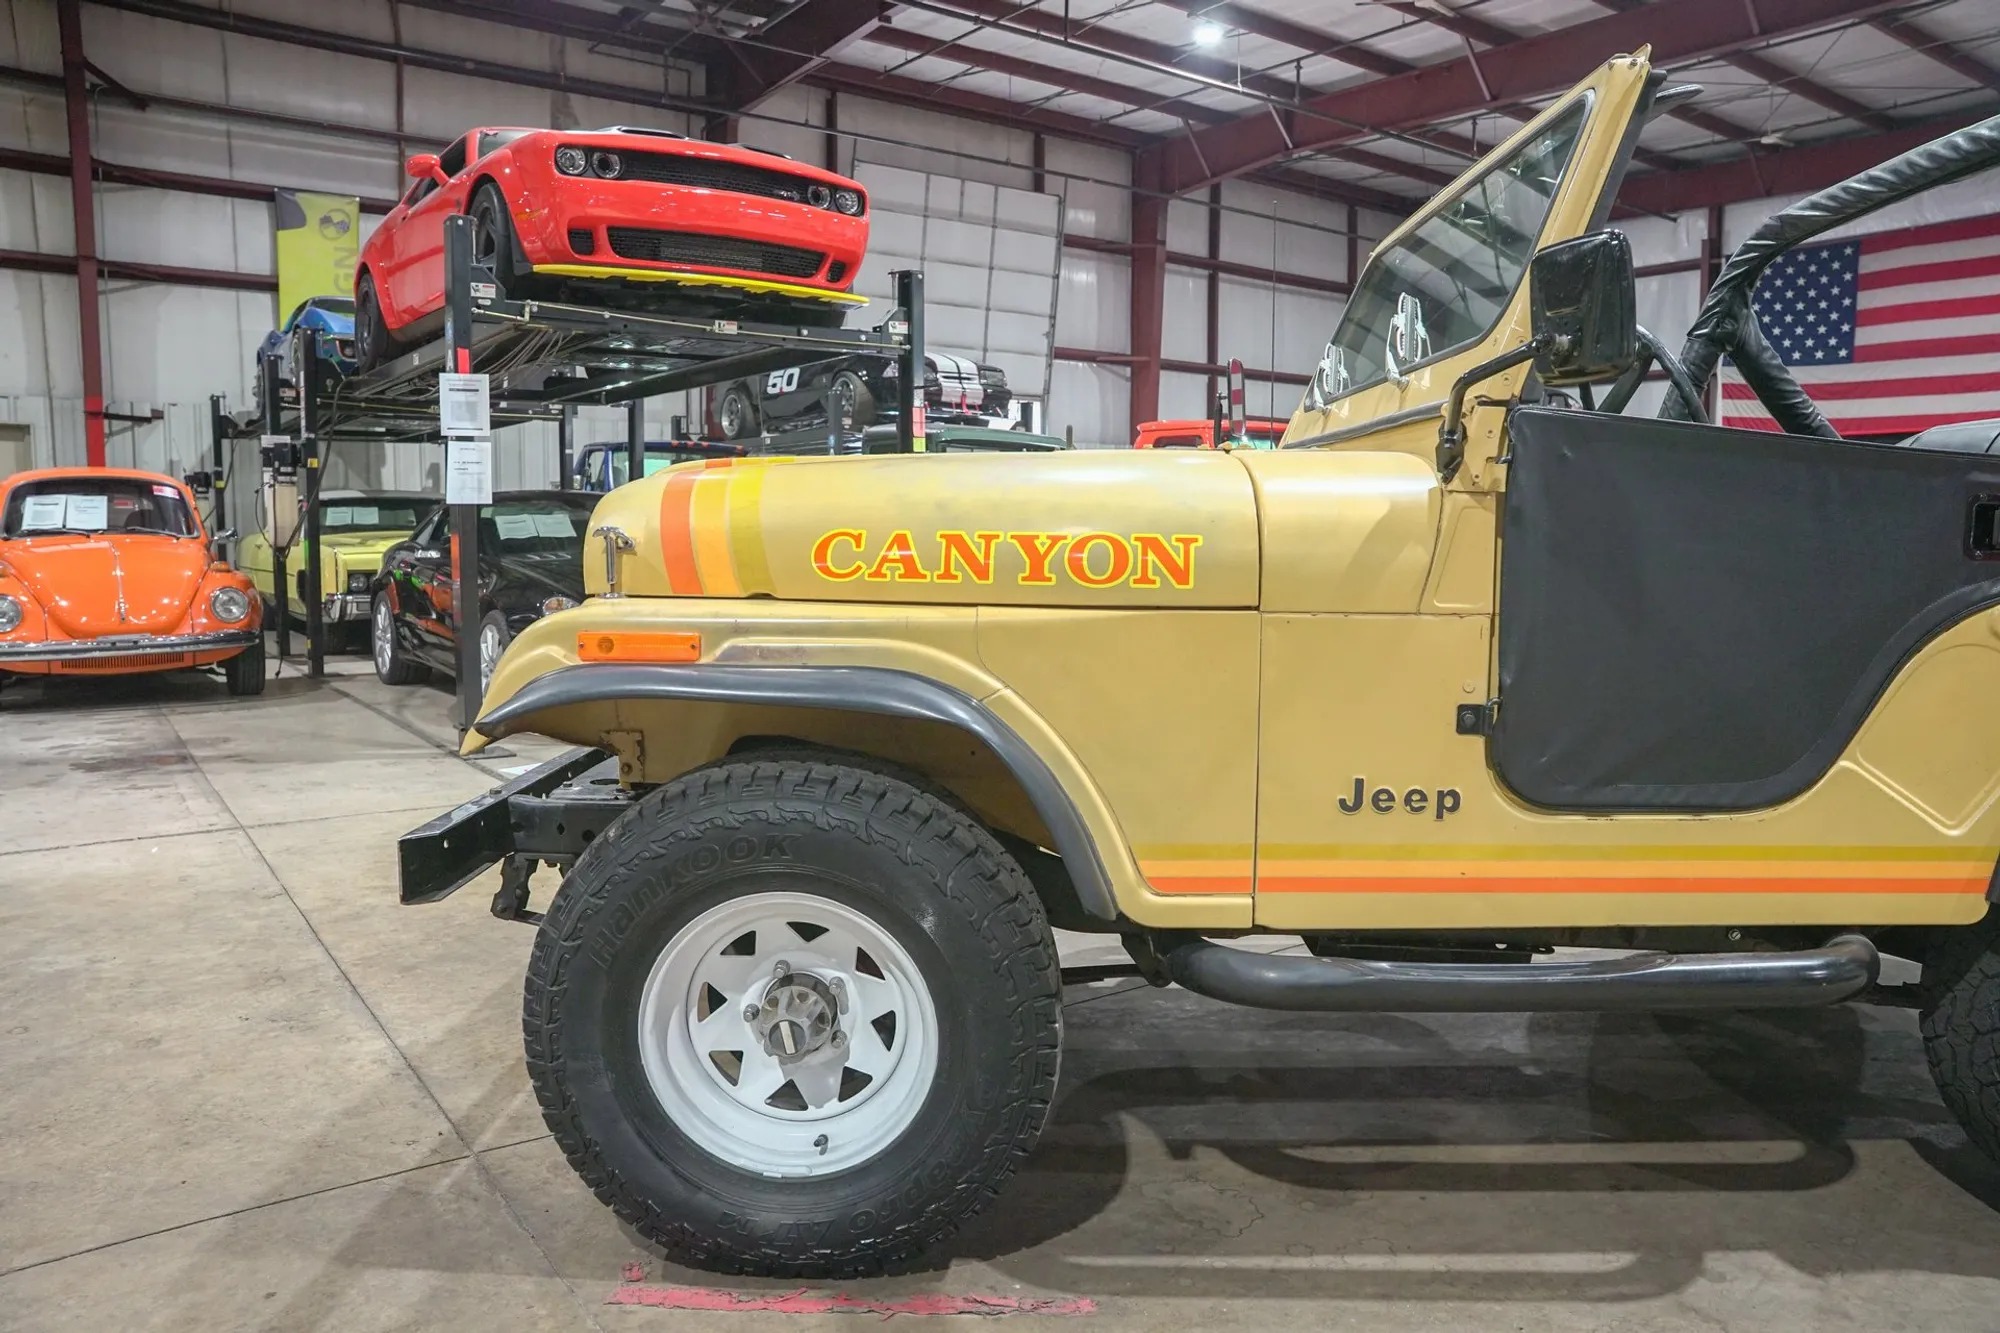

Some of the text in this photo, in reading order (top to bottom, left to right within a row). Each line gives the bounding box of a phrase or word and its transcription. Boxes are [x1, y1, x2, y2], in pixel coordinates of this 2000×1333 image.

[766, 367, 801, 395] 50
[811, 528, 1204, 589] CANYON
[1336, 775, 1462, 821] Jeep
